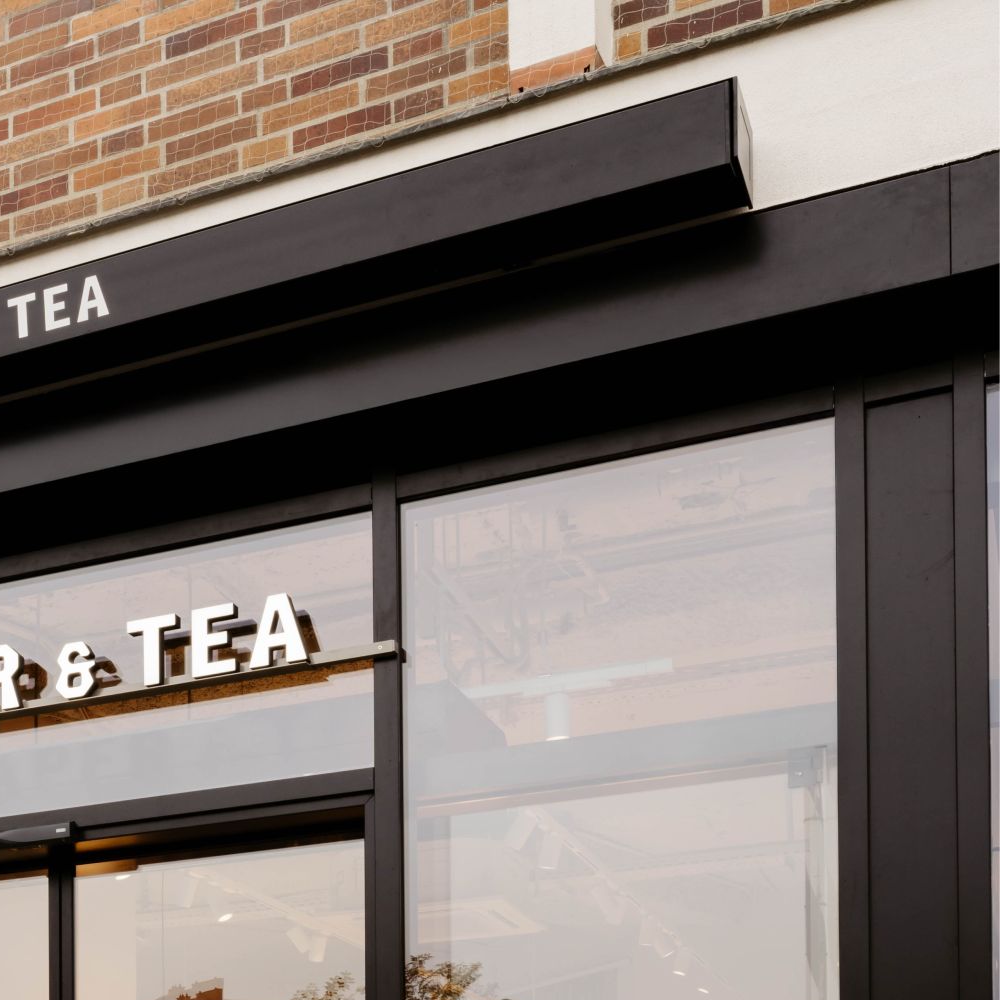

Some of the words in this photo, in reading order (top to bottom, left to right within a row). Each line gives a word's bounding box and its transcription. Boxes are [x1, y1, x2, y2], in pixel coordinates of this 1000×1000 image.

[7, 274, 110, 339] TEA
[55, 641, 95, 700] &
[126, 593, 309, 687] TEA
